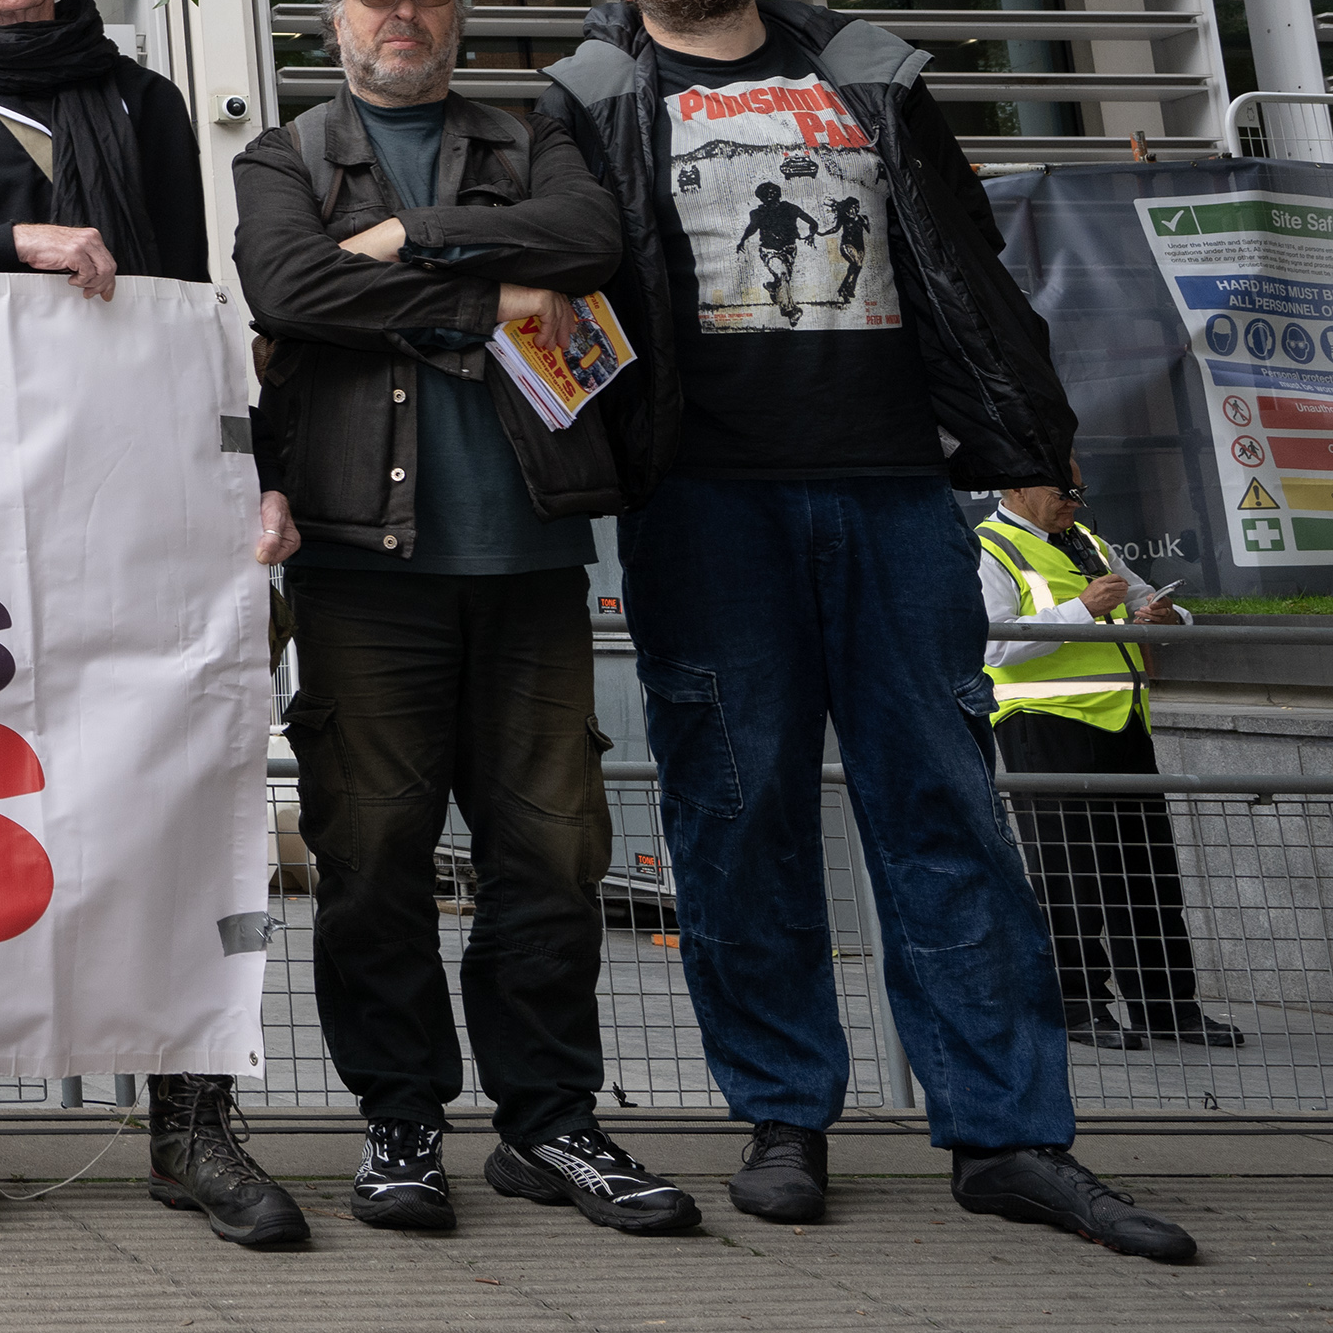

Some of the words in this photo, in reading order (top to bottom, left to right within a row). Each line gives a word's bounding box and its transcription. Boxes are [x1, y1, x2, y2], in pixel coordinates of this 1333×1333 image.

[1272, 210, 1302, 229] Site
[1216, 280, 1259, 292] HARD
[1262, 282, 1286, 296] HATS
[1288, 286, 1318, 300] MUST
[1322, 289, 1333, 300] B
[1229, 295, 1252, 308] ALL
[1256, 298, 1319, 316] PERSONNEL
[1322, 305, 1333, 316] O
[534, 351, 570, 402] campaigning
[1261, 368, 1300, 380] Personal
[1278, 381, 1302, 389] must
[1300, 382, 1314, 390] be
[600, 598, 617, 607] TONE
